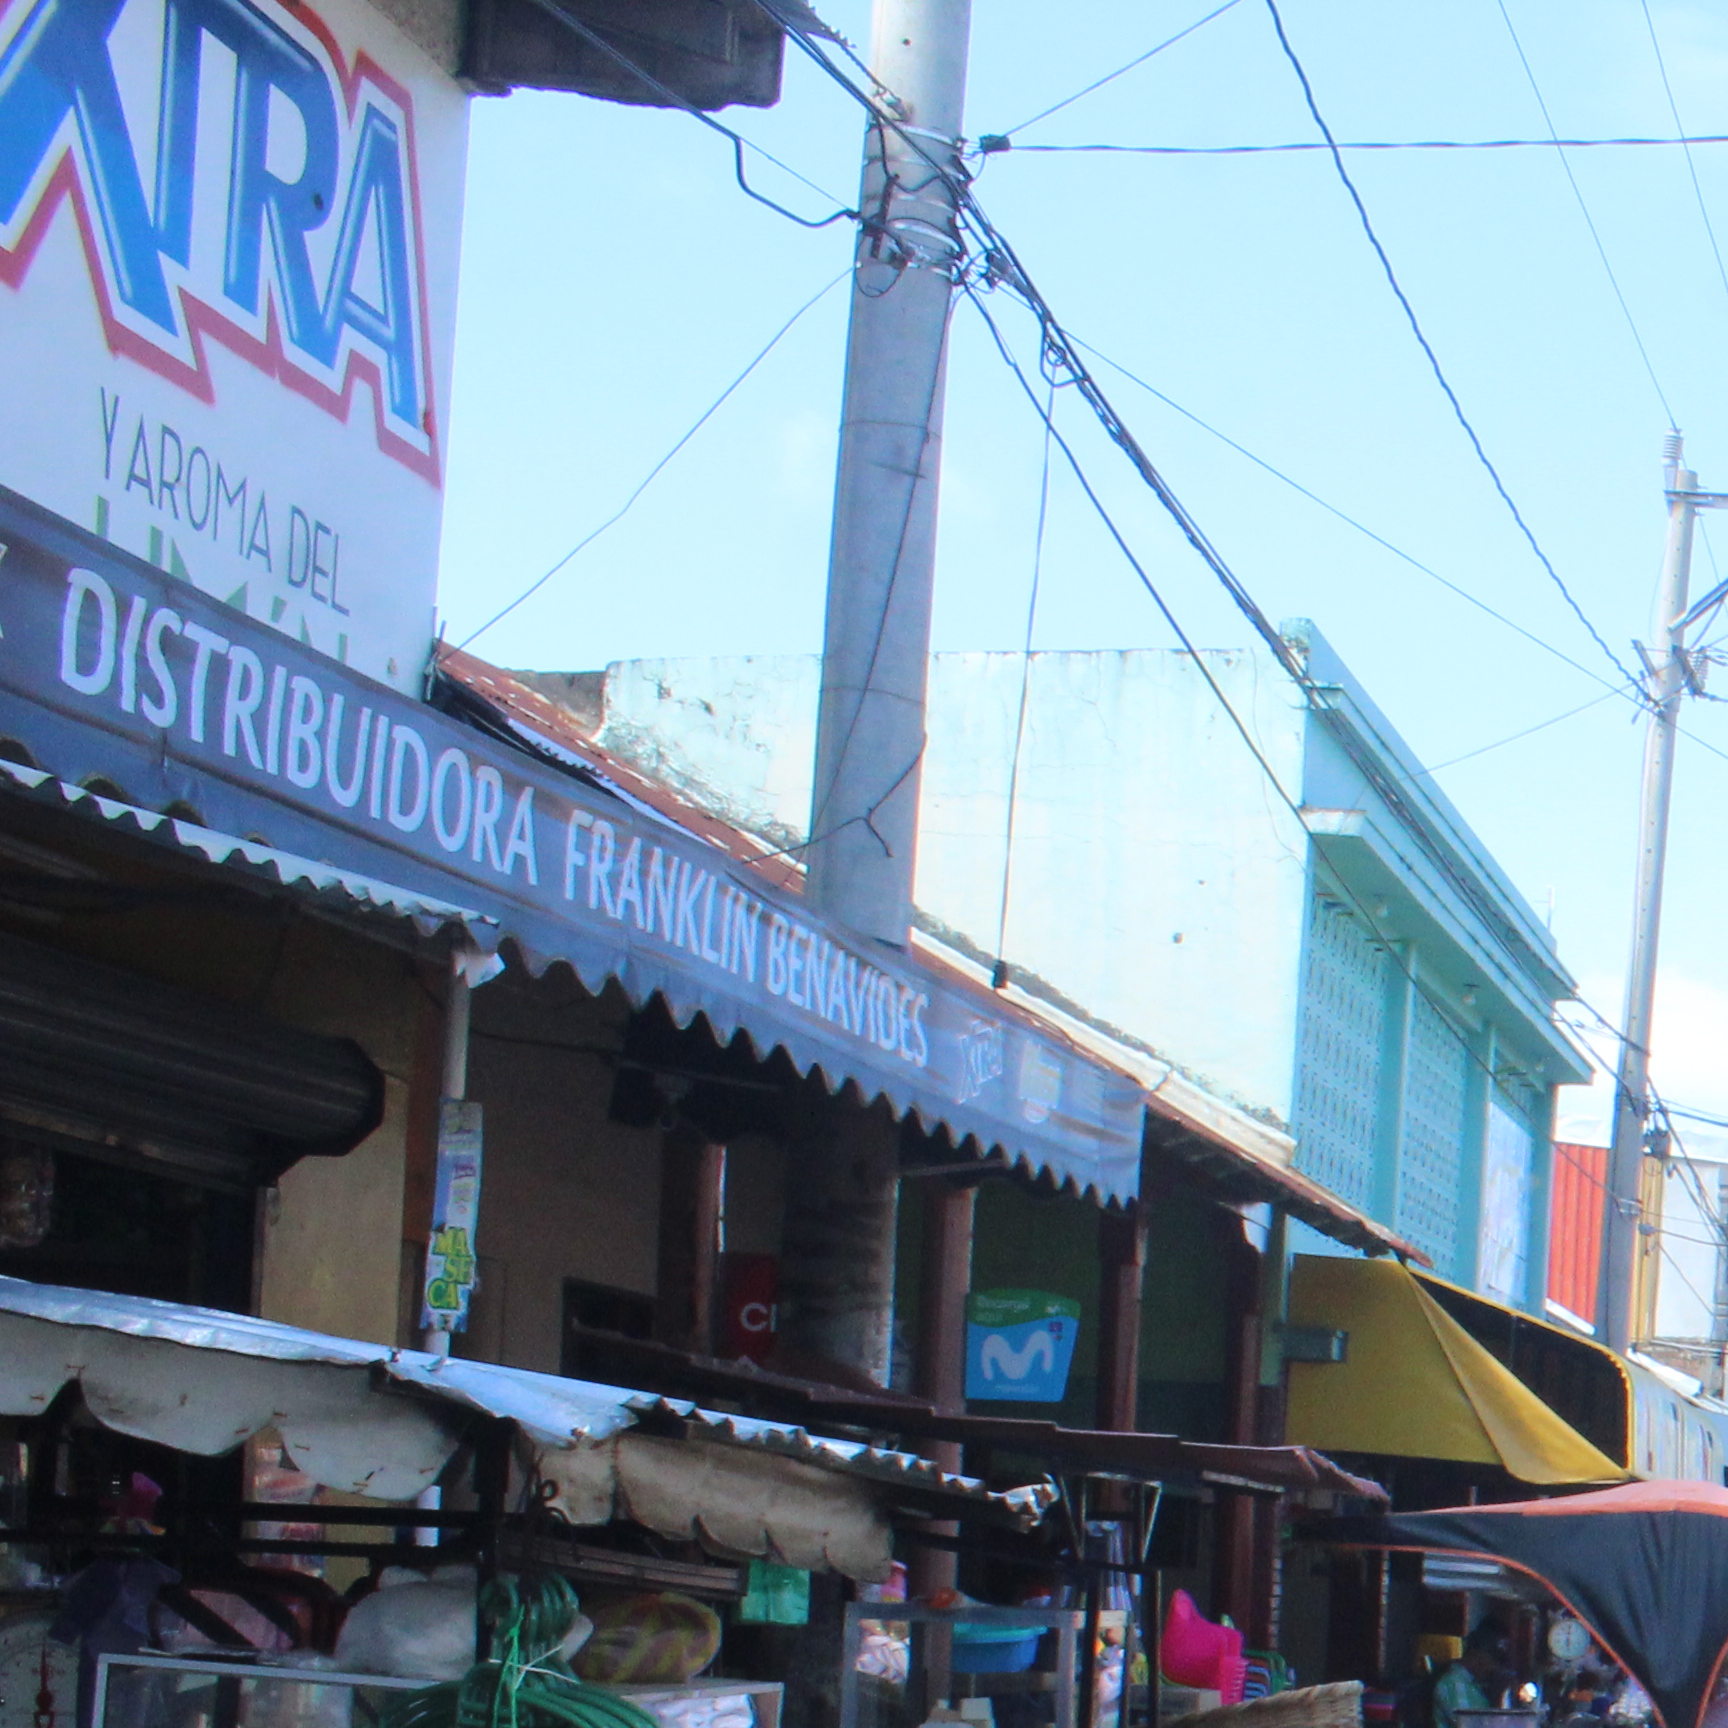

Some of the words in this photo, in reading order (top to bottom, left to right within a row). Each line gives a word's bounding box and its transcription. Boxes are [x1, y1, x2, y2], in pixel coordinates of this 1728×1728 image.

[101, 386, 120, 481] Y
[126, 413, 273, 574] AROMA
[287, 504, 350, 618] DEL
[60, 566, 539, 886] DISTRIBUIDORA
[563, 808, 766, 982] FRANKLIN
[766, 910, 930, 1068] BENAVIDES
